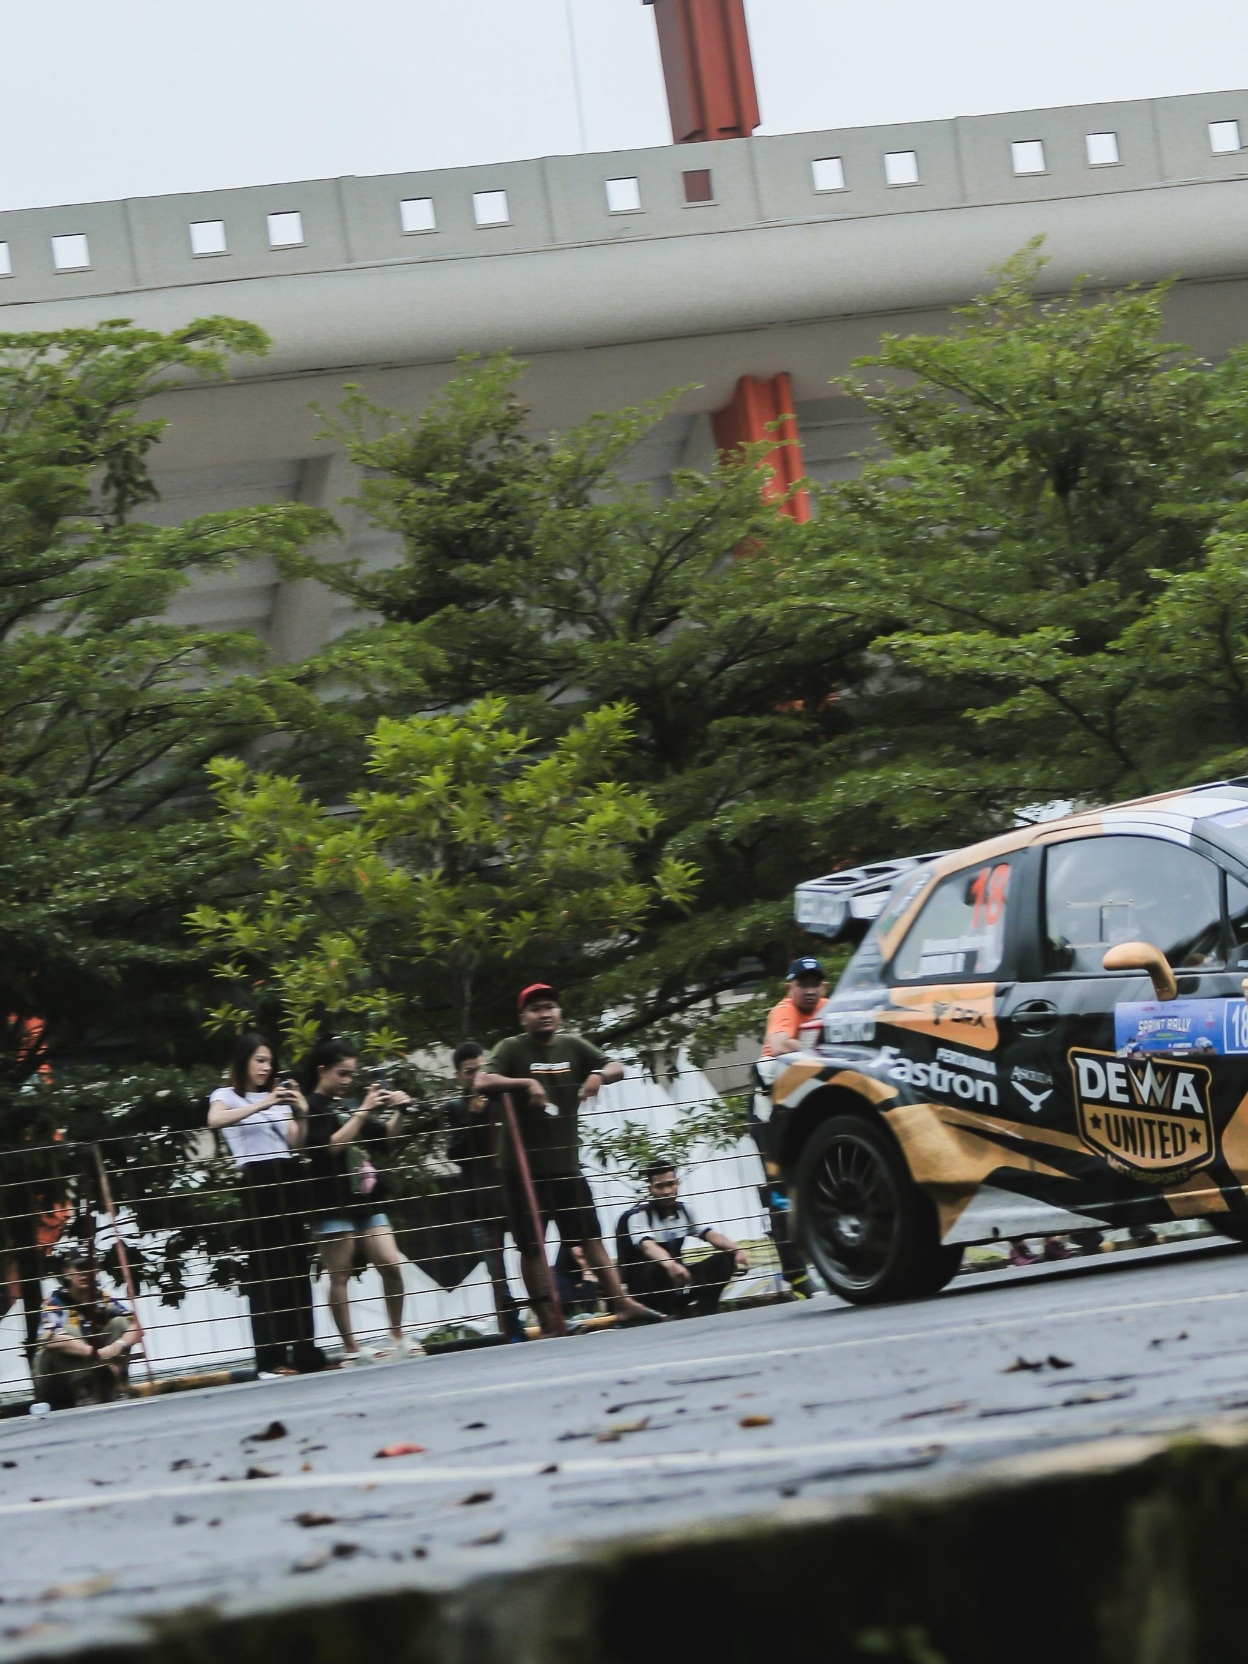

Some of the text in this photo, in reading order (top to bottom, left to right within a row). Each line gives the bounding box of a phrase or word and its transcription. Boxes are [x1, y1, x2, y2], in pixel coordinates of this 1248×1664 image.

[970, 863, 1011, 929] 18
[1138, 1017, 1192, 1038] SPRINT RALLY
[867, 1045, 999, 1106] Fastron
[1074, 1057, 1205, 1114] DEWA
[1103, 1112, 1187, 1160] UNITED
